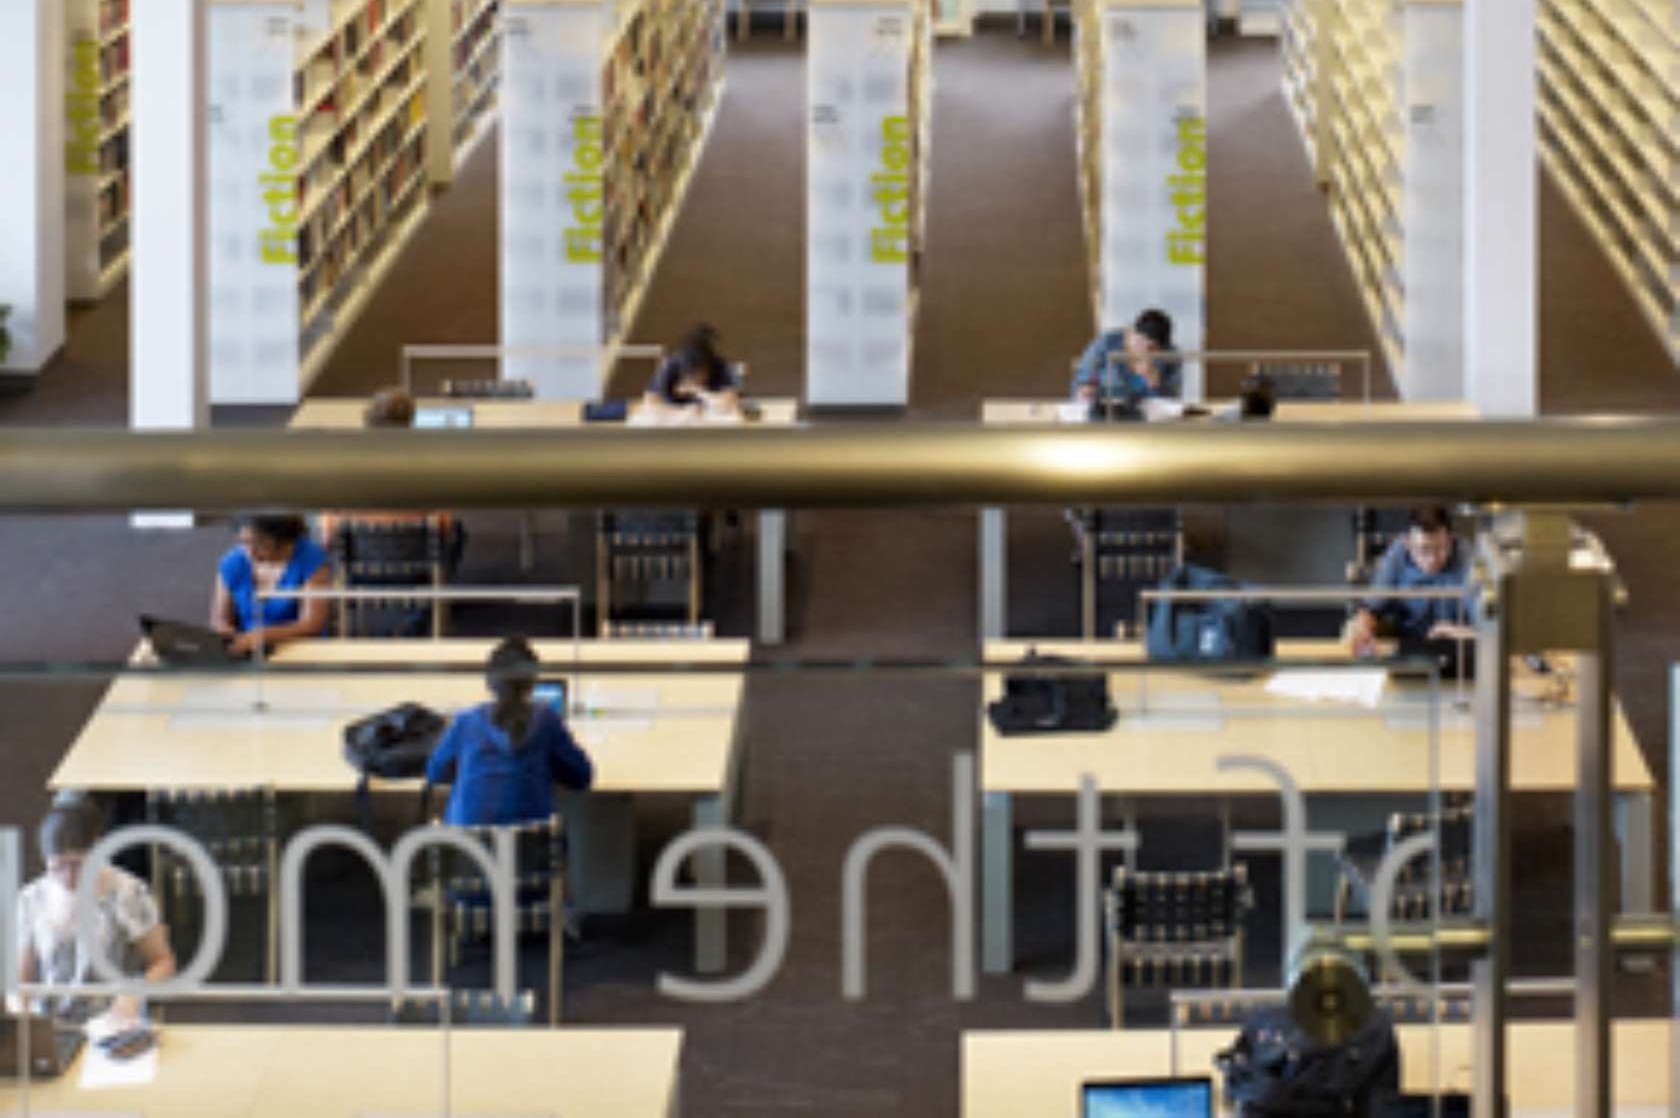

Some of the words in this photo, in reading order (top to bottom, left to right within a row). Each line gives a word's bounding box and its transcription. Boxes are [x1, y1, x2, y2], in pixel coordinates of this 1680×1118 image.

[259, 115, 301, 264] Fiction
[563, 115, 602, 264] Fiction
[870, 115, 911, 264] Fiction
[1166, 117, 1206, 265] Fiction
